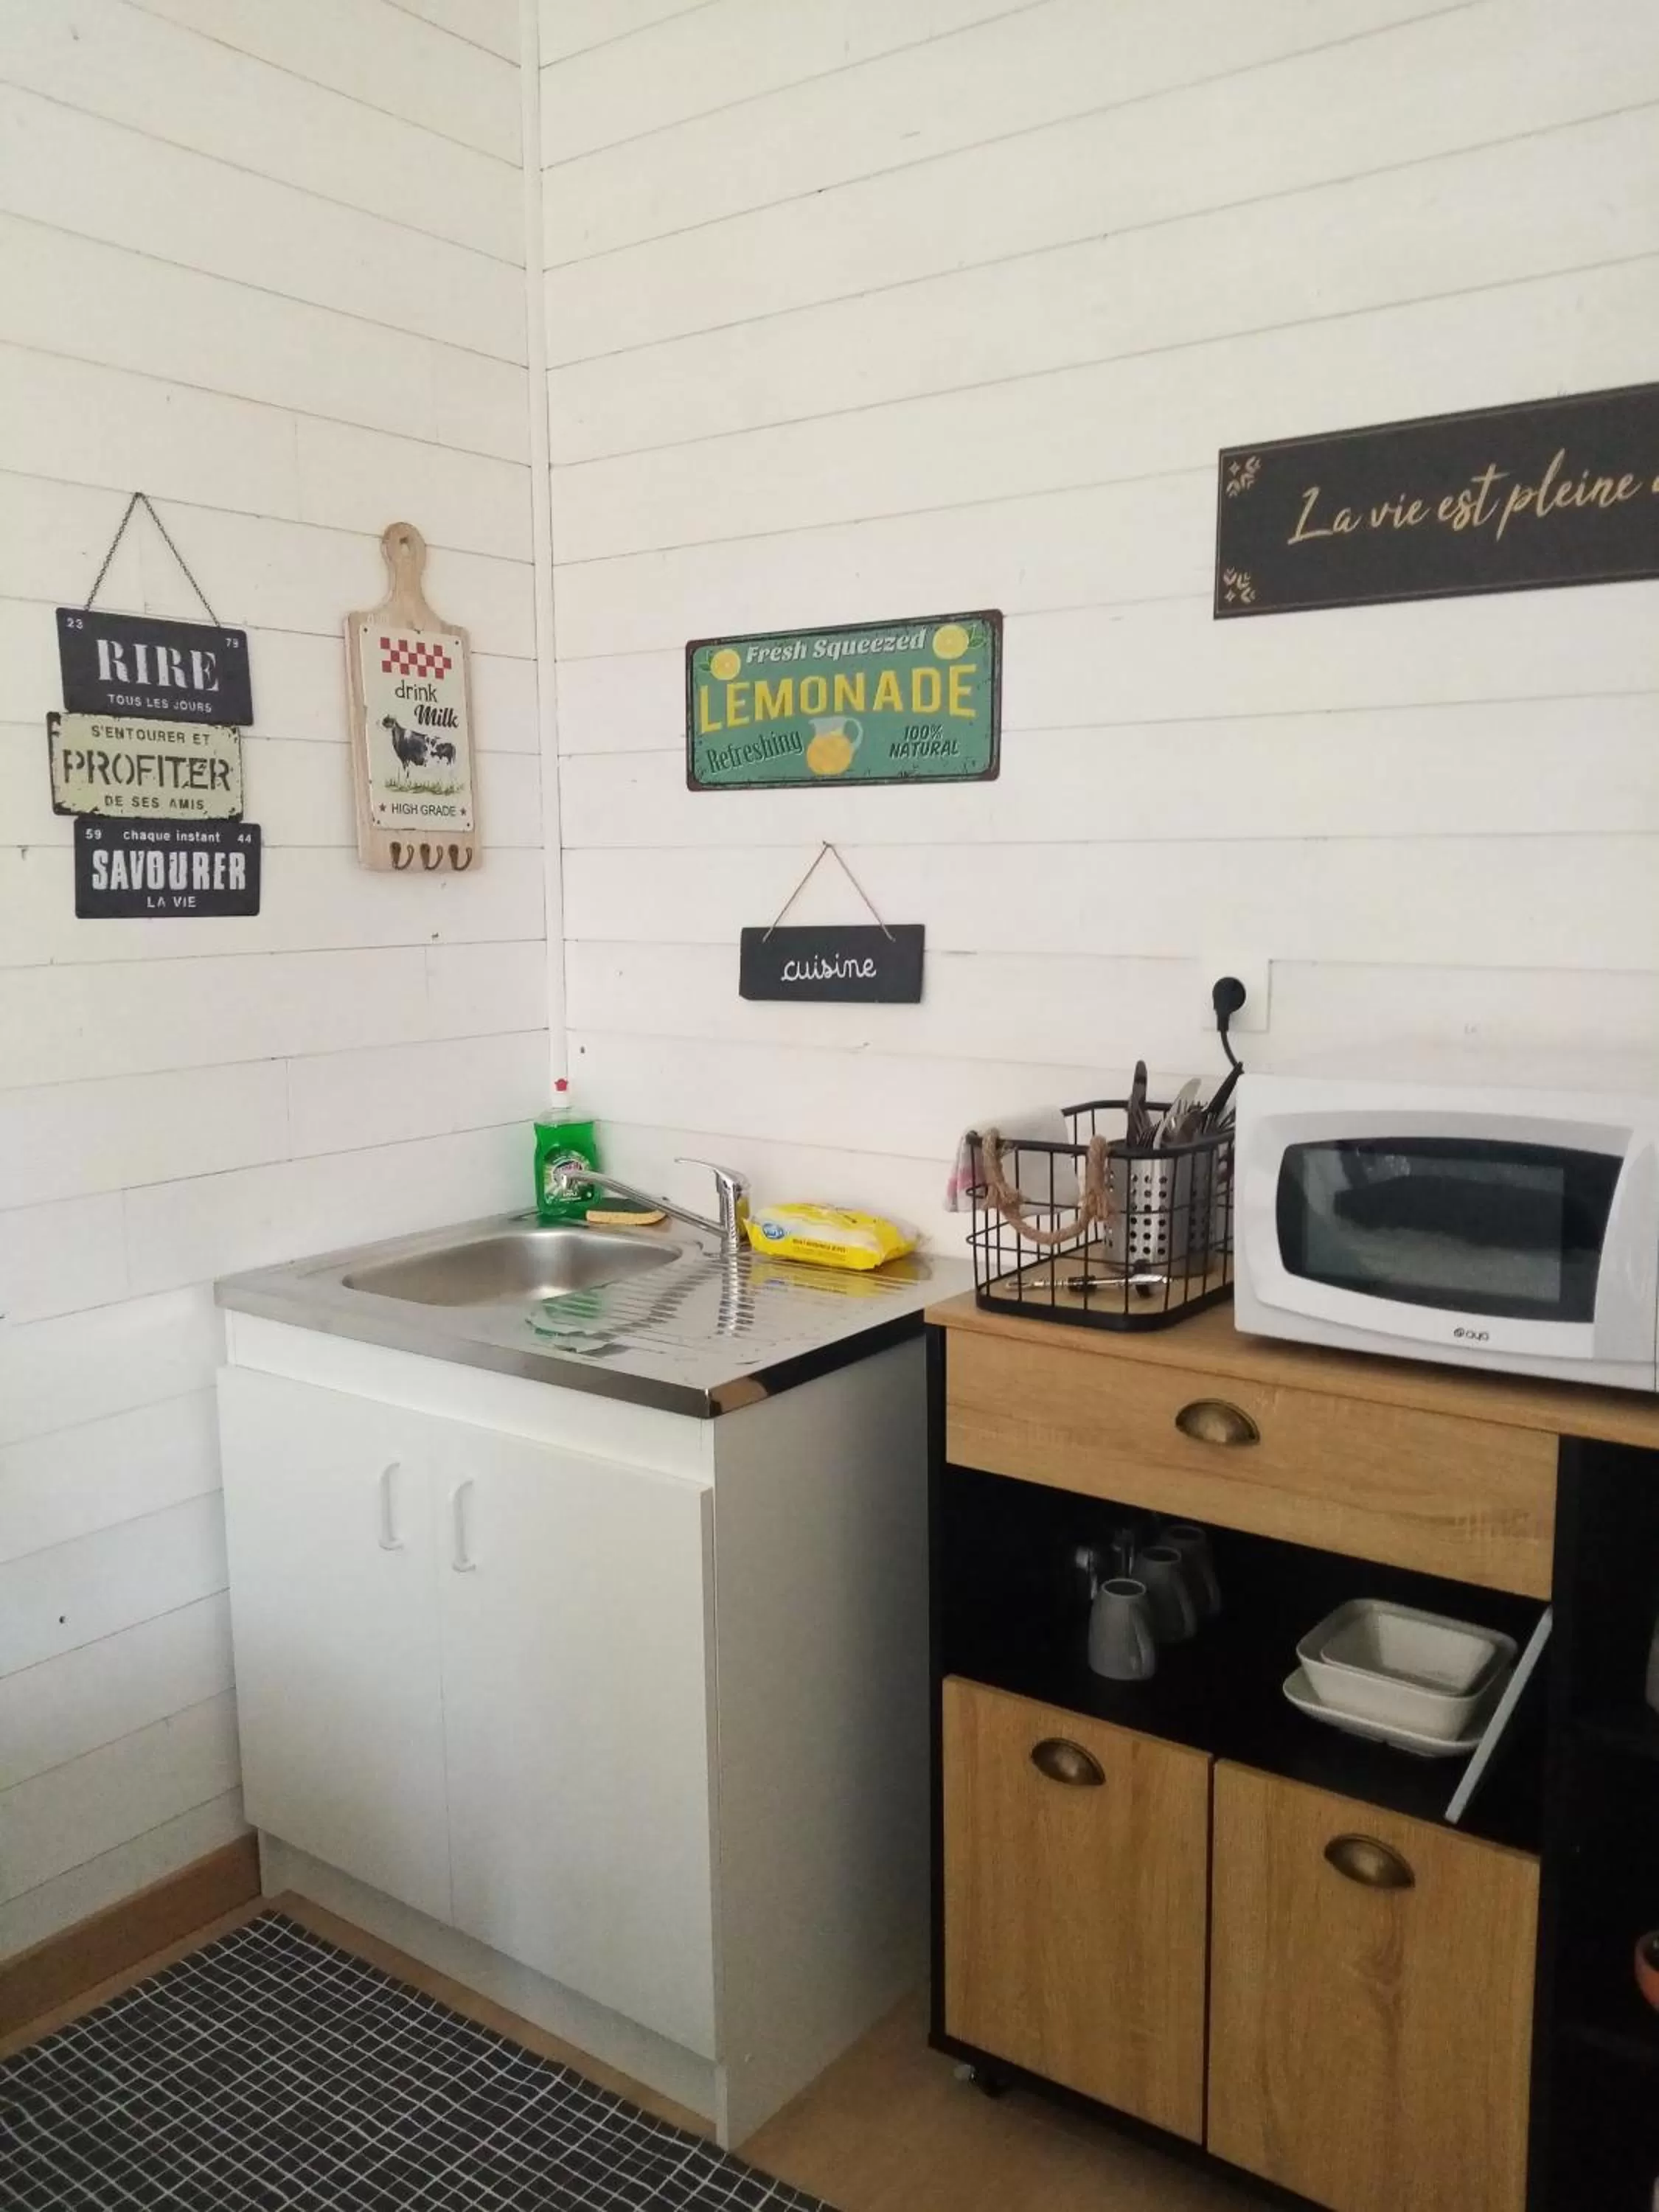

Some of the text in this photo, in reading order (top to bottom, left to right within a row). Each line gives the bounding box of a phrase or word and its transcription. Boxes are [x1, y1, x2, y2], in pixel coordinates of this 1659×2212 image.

[1287, 447, 1643, 545] La vie est pleine
[66, 616, 83, 630] 23
[745, 625, 928, 664] Fresh Squeezed
[95, 639, 220, 692] RIRE
[107, 693, 212, 713] TOUS LES JOURS
[394, 678, 438, 703] drink
[698, 663, 978, 734] LEMONADE
[414, 703, 459, 728] Milk
[91, 724, 211, 745] S'ENTOURER ET
[903, 725, 943, 741] 100%
[706, 730, 803, 775] Refreshing
[888, 740, 960, 759] NATURAL
[63, 748, 231, 791] PROFITER
[104, 795, 205, 810] DE SES AMIS
[391, 802, 457, 817] HIGH GRADE
[85, 828, 252, 844] 59 chaque instant 44
[91, 849, 246, 890] SAVOURER
[147, 896, 197, 908] LA VIE
[780, 953, 877, 982] cuisine
